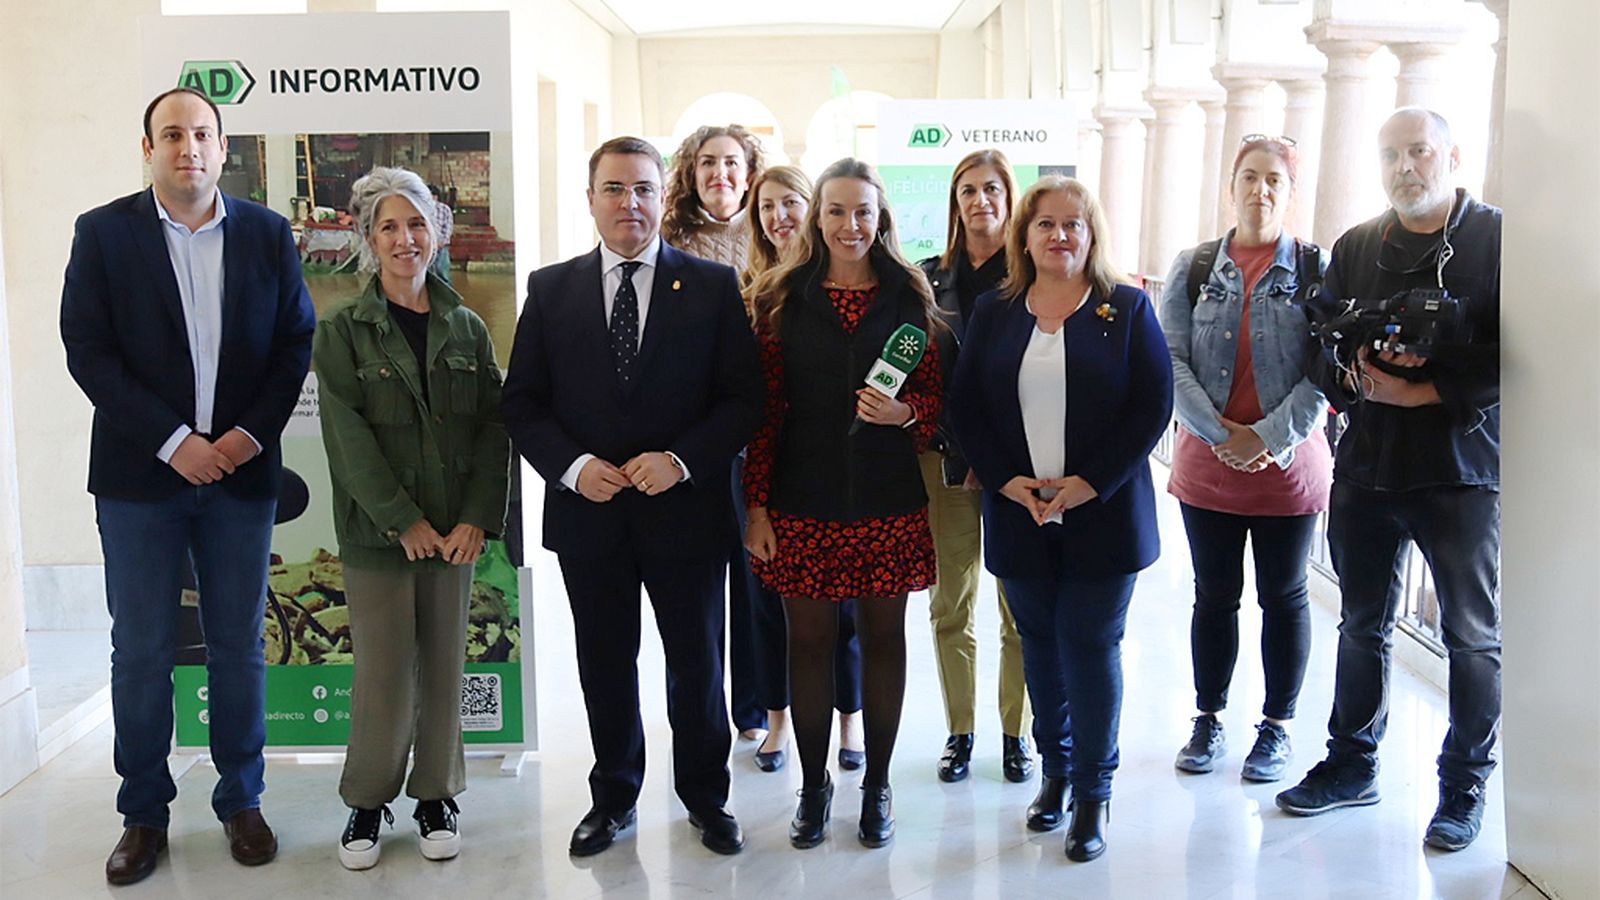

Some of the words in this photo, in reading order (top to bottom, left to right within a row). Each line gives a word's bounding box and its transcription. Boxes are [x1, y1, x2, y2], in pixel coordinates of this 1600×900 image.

[184, 68, 234, 98] AD
[269, 66, 480, 94] INFORMATIVO
[911, 128, 941, 144] AD
[961, 129, 1048, 143] VETERANO
[918, 239, 933, 249] AD
